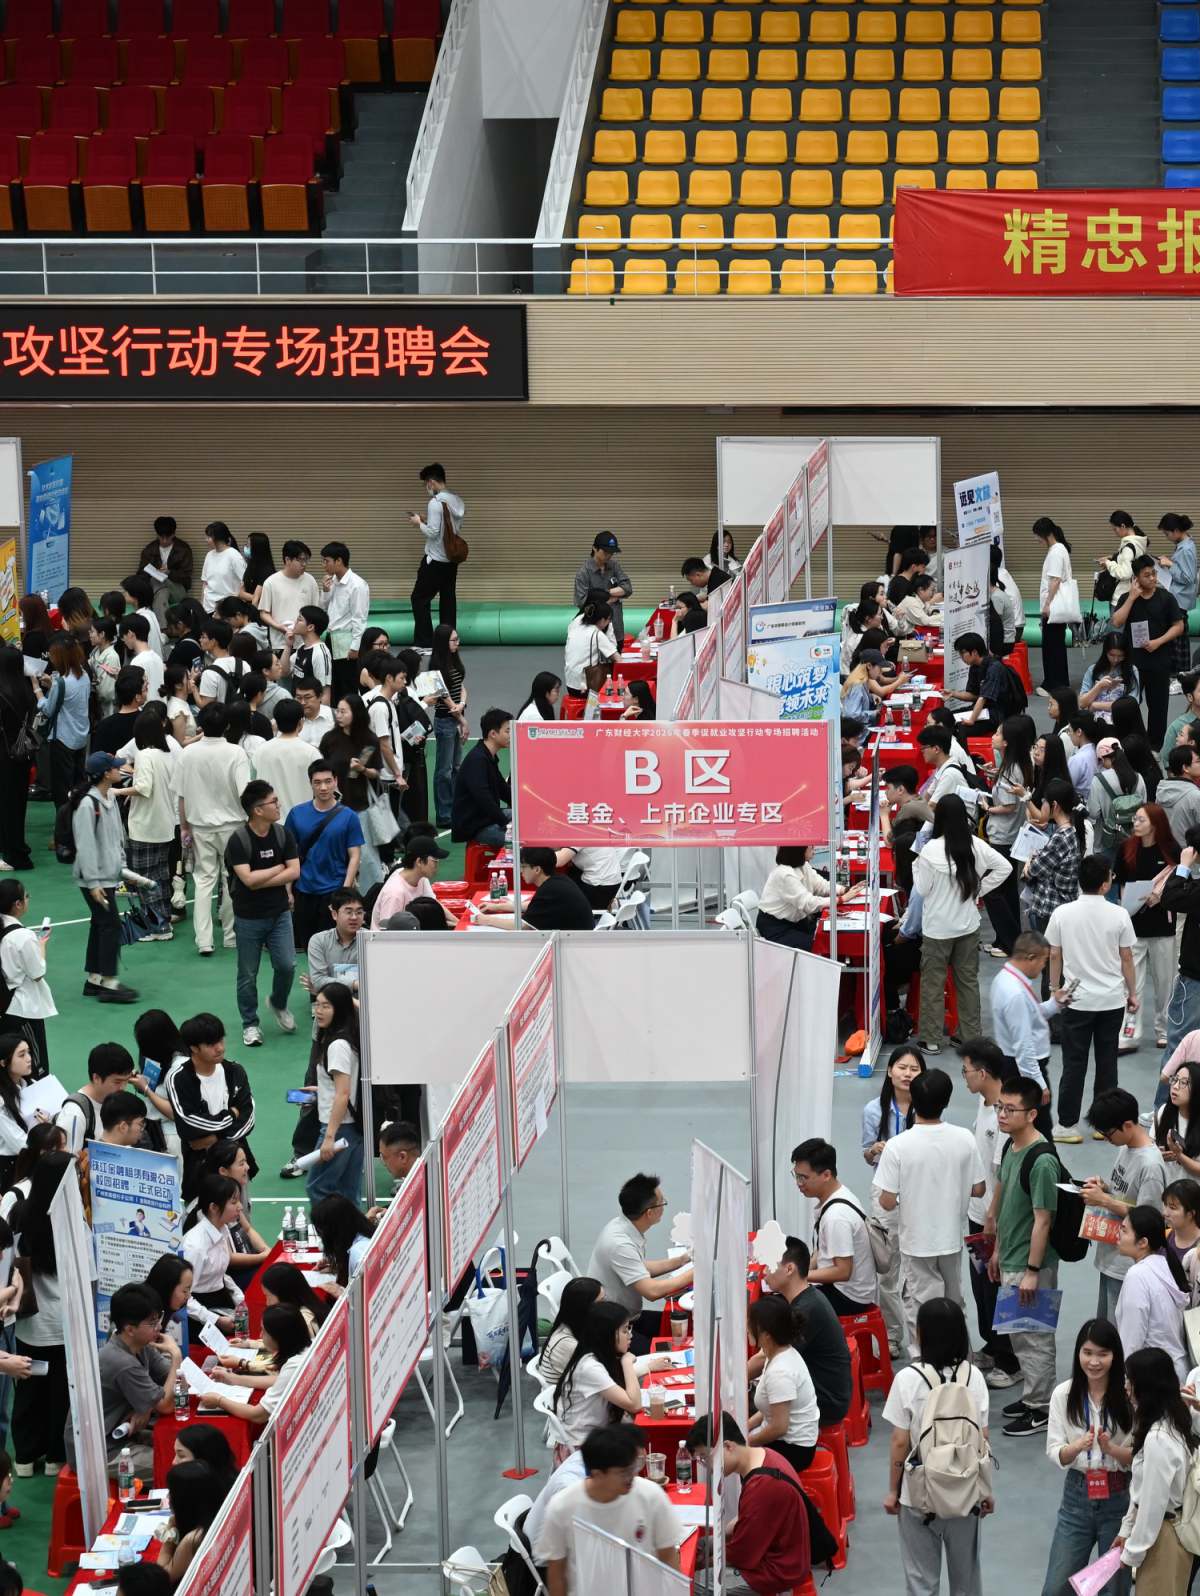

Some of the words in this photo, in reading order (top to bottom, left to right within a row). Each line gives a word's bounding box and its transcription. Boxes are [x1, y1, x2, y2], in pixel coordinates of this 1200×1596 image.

[2, 325, 490, 377] 攻坚行动专场招聘会
[624, 750, 731, 795] B区
[567, 802, 784, 825] 基金、上市企业专区
